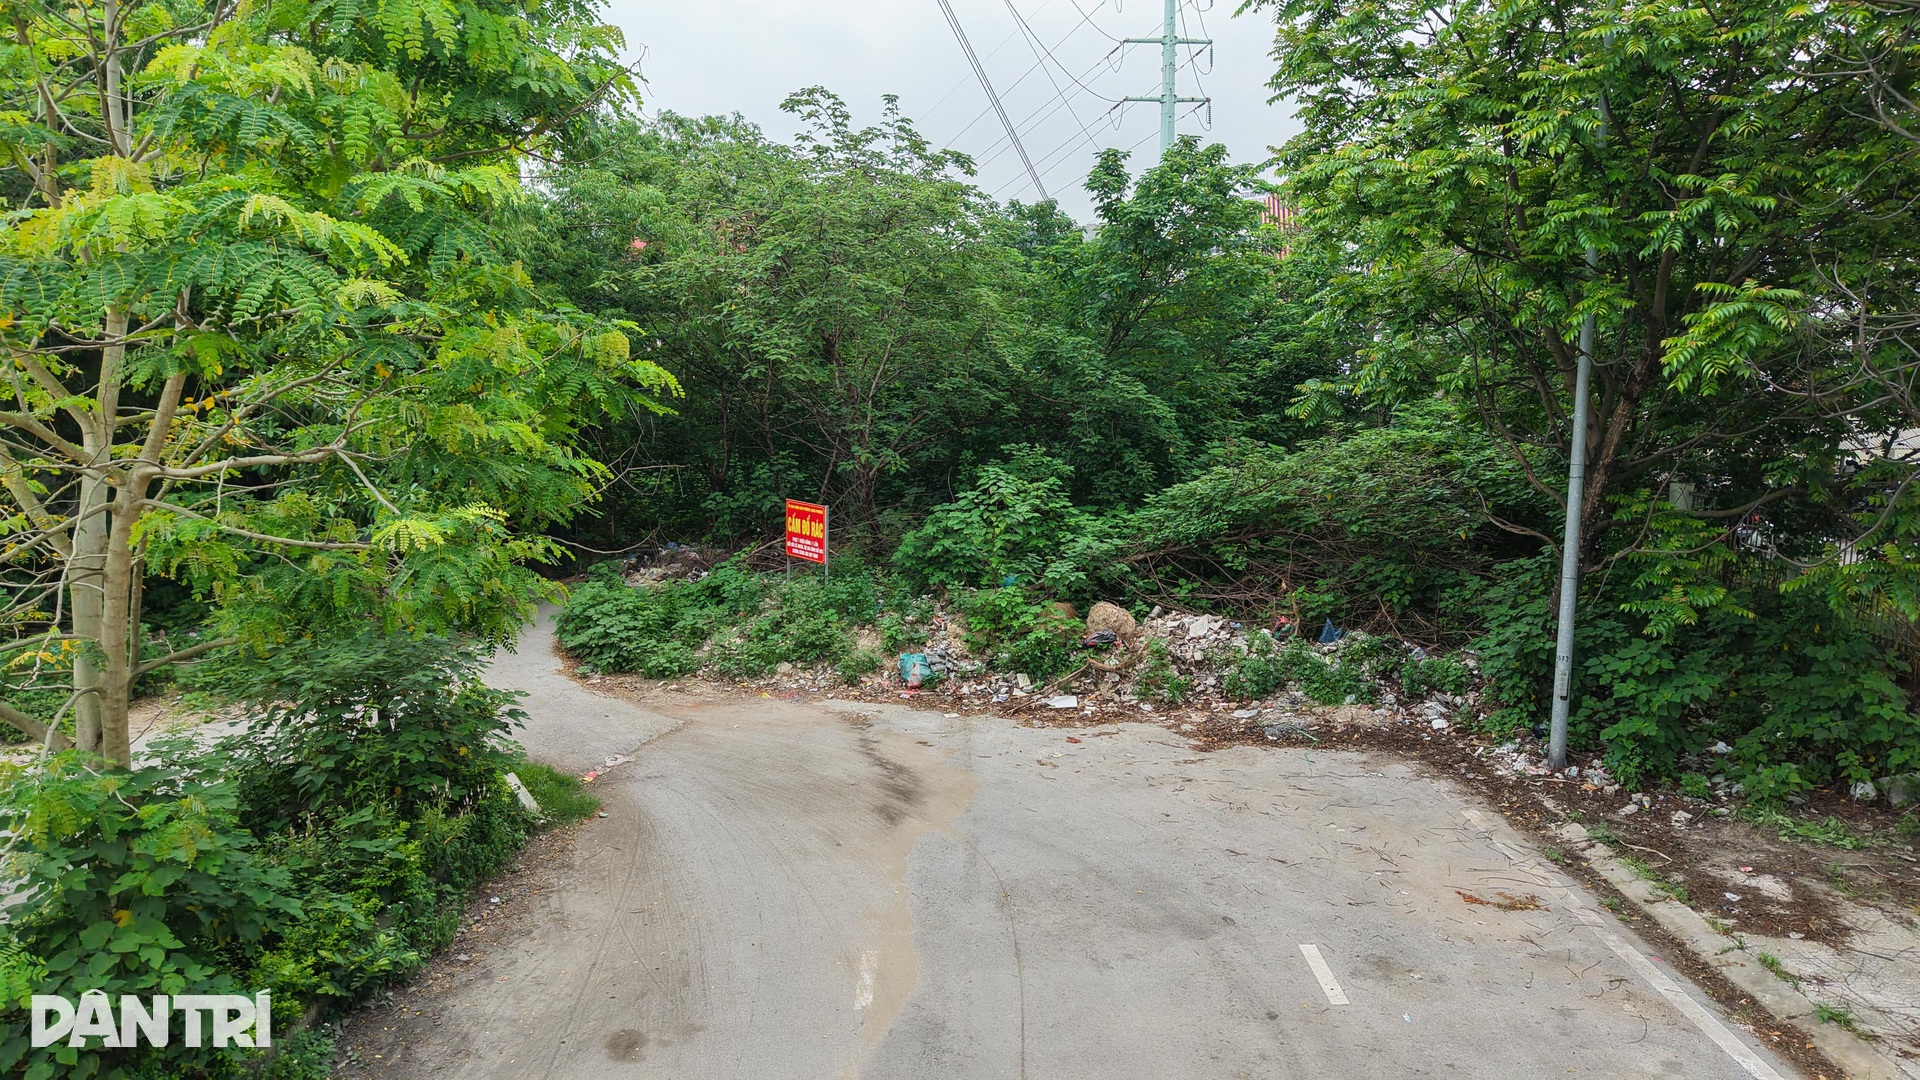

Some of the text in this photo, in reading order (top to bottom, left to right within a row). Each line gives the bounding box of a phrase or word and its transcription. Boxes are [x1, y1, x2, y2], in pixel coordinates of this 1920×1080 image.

[788, 512, 824, 539] CẤM ĐỔ RÁC
